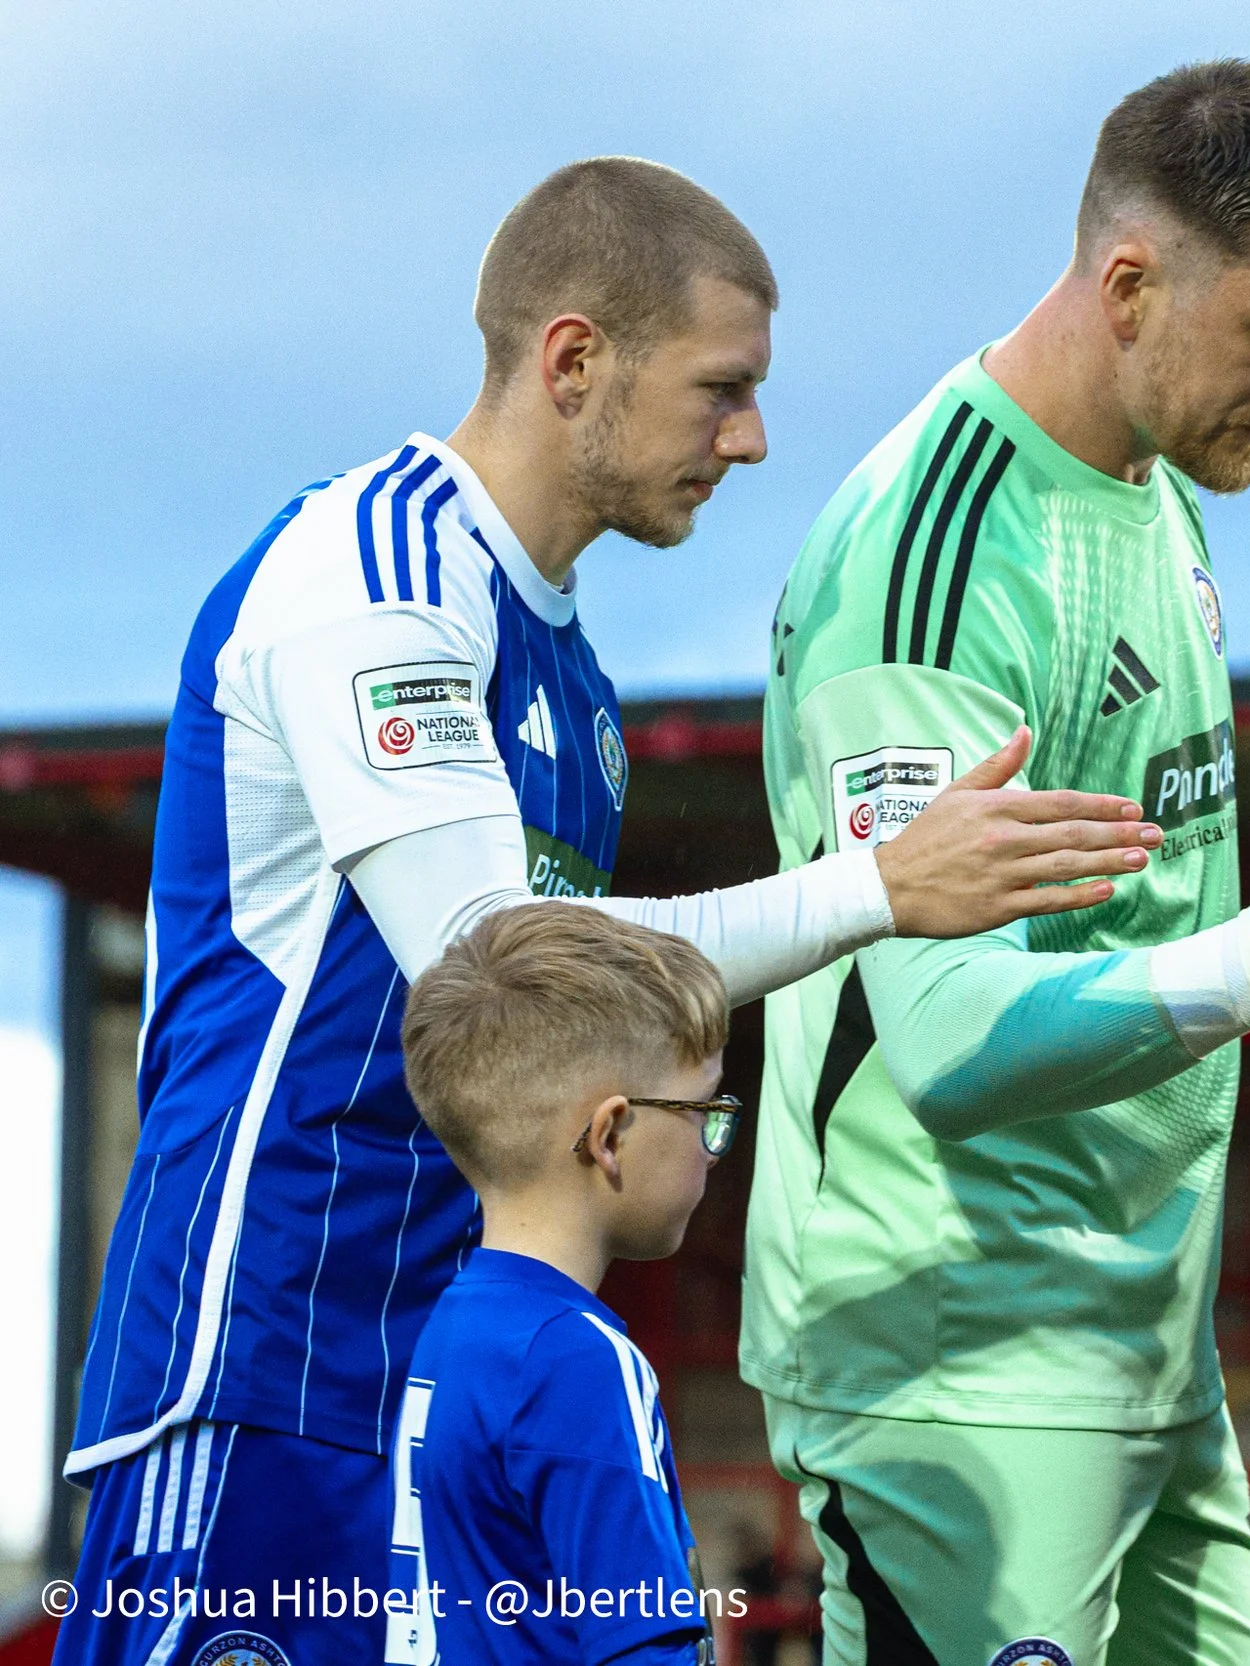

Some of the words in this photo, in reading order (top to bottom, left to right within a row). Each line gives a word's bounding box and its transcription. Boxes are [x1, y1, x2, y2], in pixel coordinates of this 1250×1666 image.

[373, 682, 471, 703] enterprise
[416, 716, 480, 731] NATIONA
[428, 729, 480, 743] LEAGUE
[849, 766, 939, 790] enterprise
[876, 799, 930, 812] ATIONA
[250, 1639, 287, 1666] ASHTO
[996, 1643, 1035, 1666] URZON
